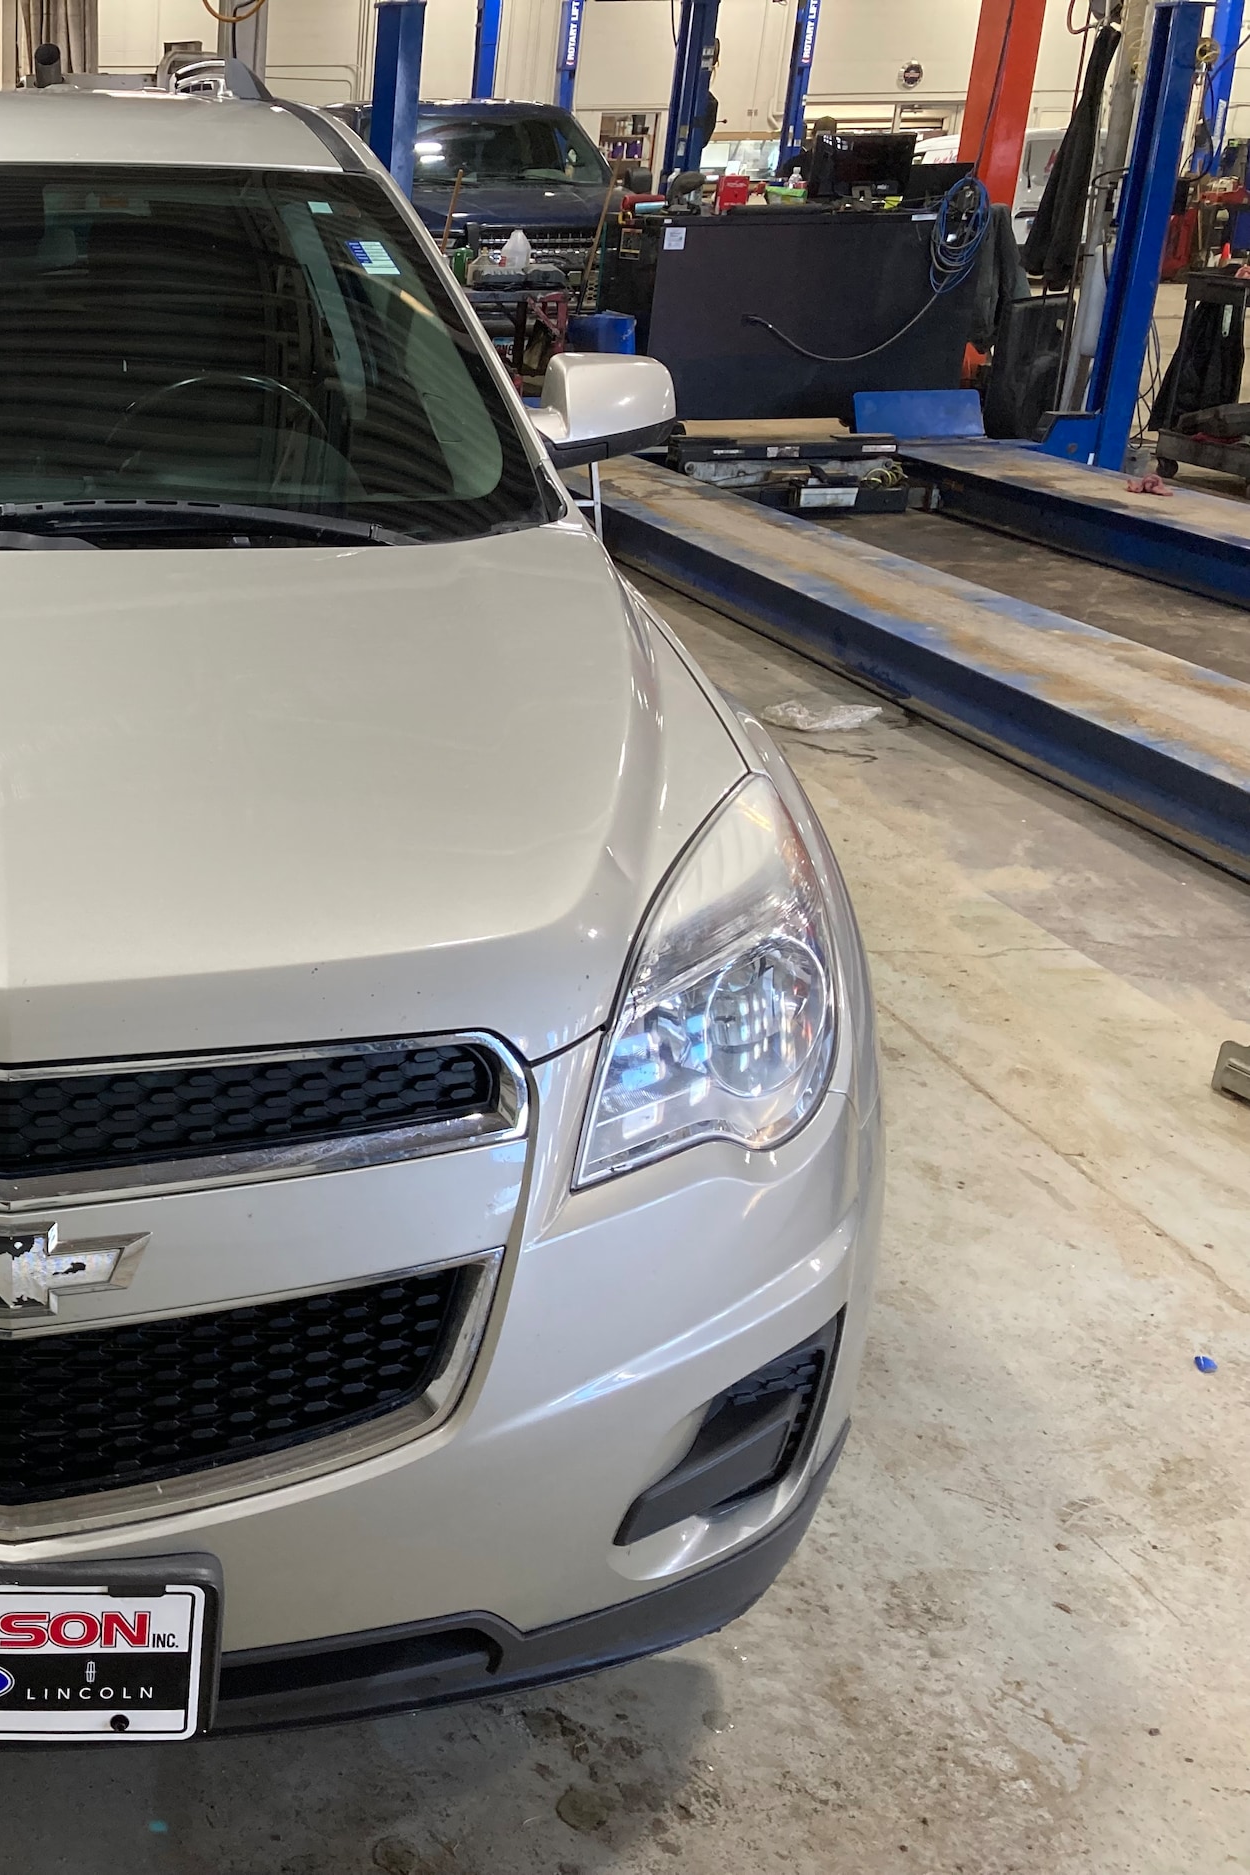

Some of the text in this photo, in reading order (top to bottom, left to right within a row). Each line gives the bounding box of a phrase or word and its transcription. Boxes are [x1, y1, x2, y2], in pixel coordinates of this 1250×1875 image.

[567, 1, 580, 60] ROTARY LIFT
[803, 21, 814, 58] ROTARY
[152, 1633, 179, 1648] INC.
[26, 1686, 153, 1700] LINCOLN
